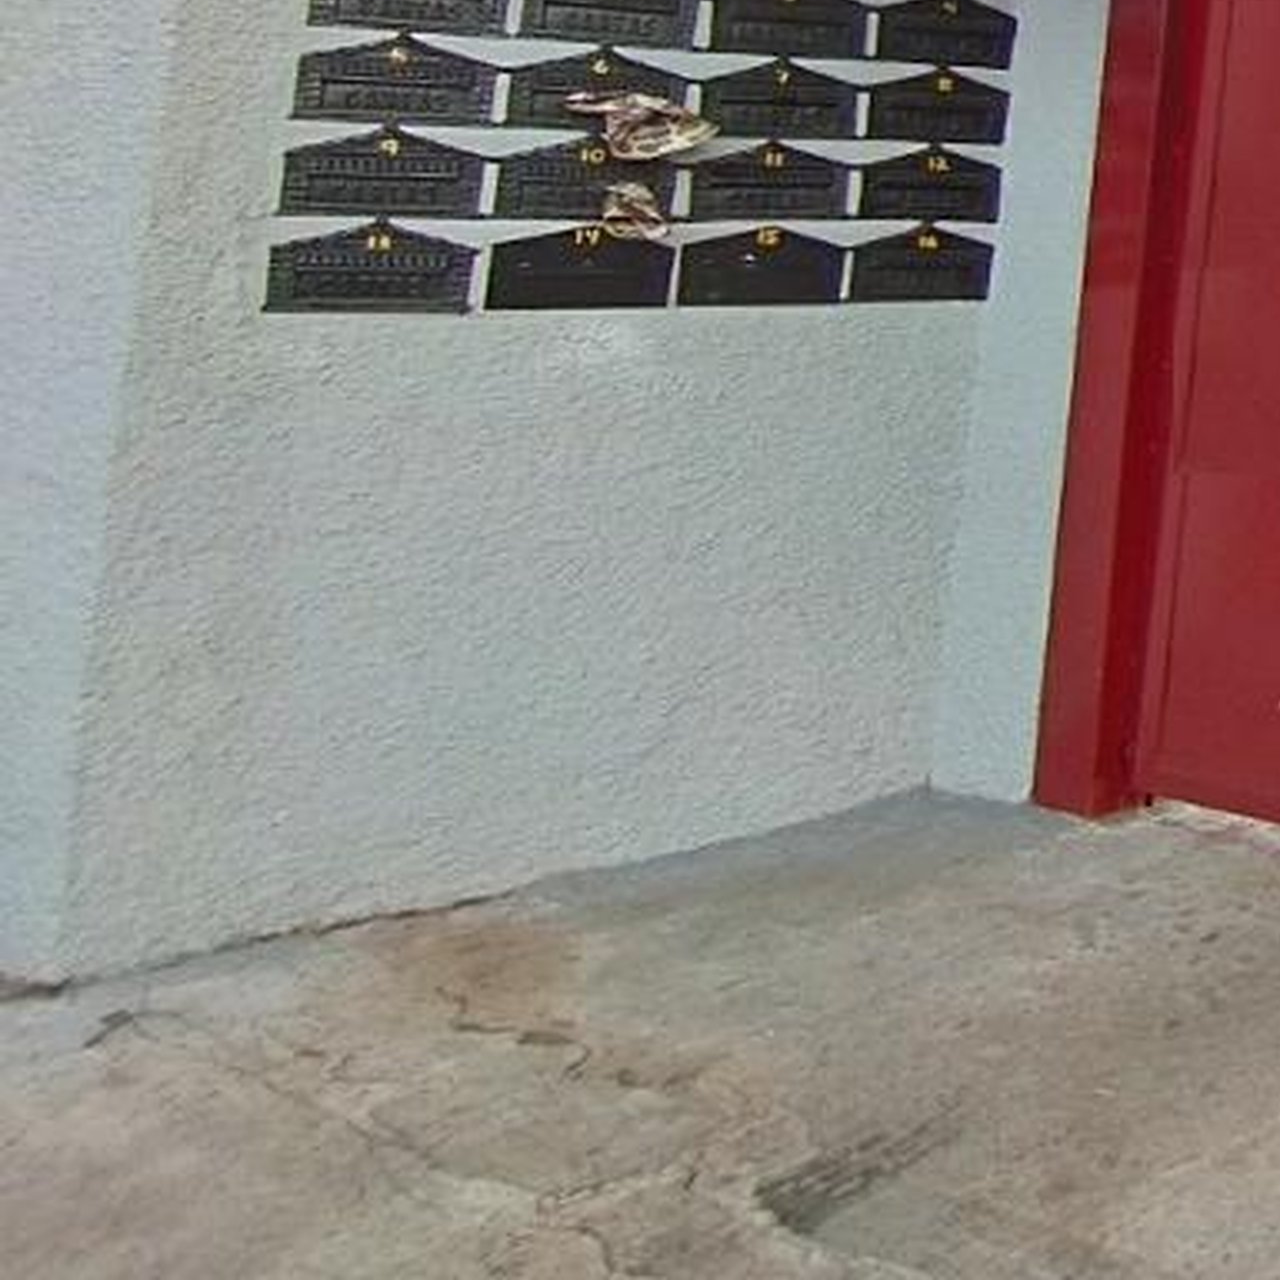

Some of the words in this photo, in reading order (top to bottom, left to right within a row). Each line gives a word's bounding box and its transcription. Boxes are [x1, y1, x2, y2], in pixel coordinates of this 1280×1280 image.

[380, 138, 400, 157] 9
[580, 147, 607, 164] 10
[764, 152, 785, 168] 11
